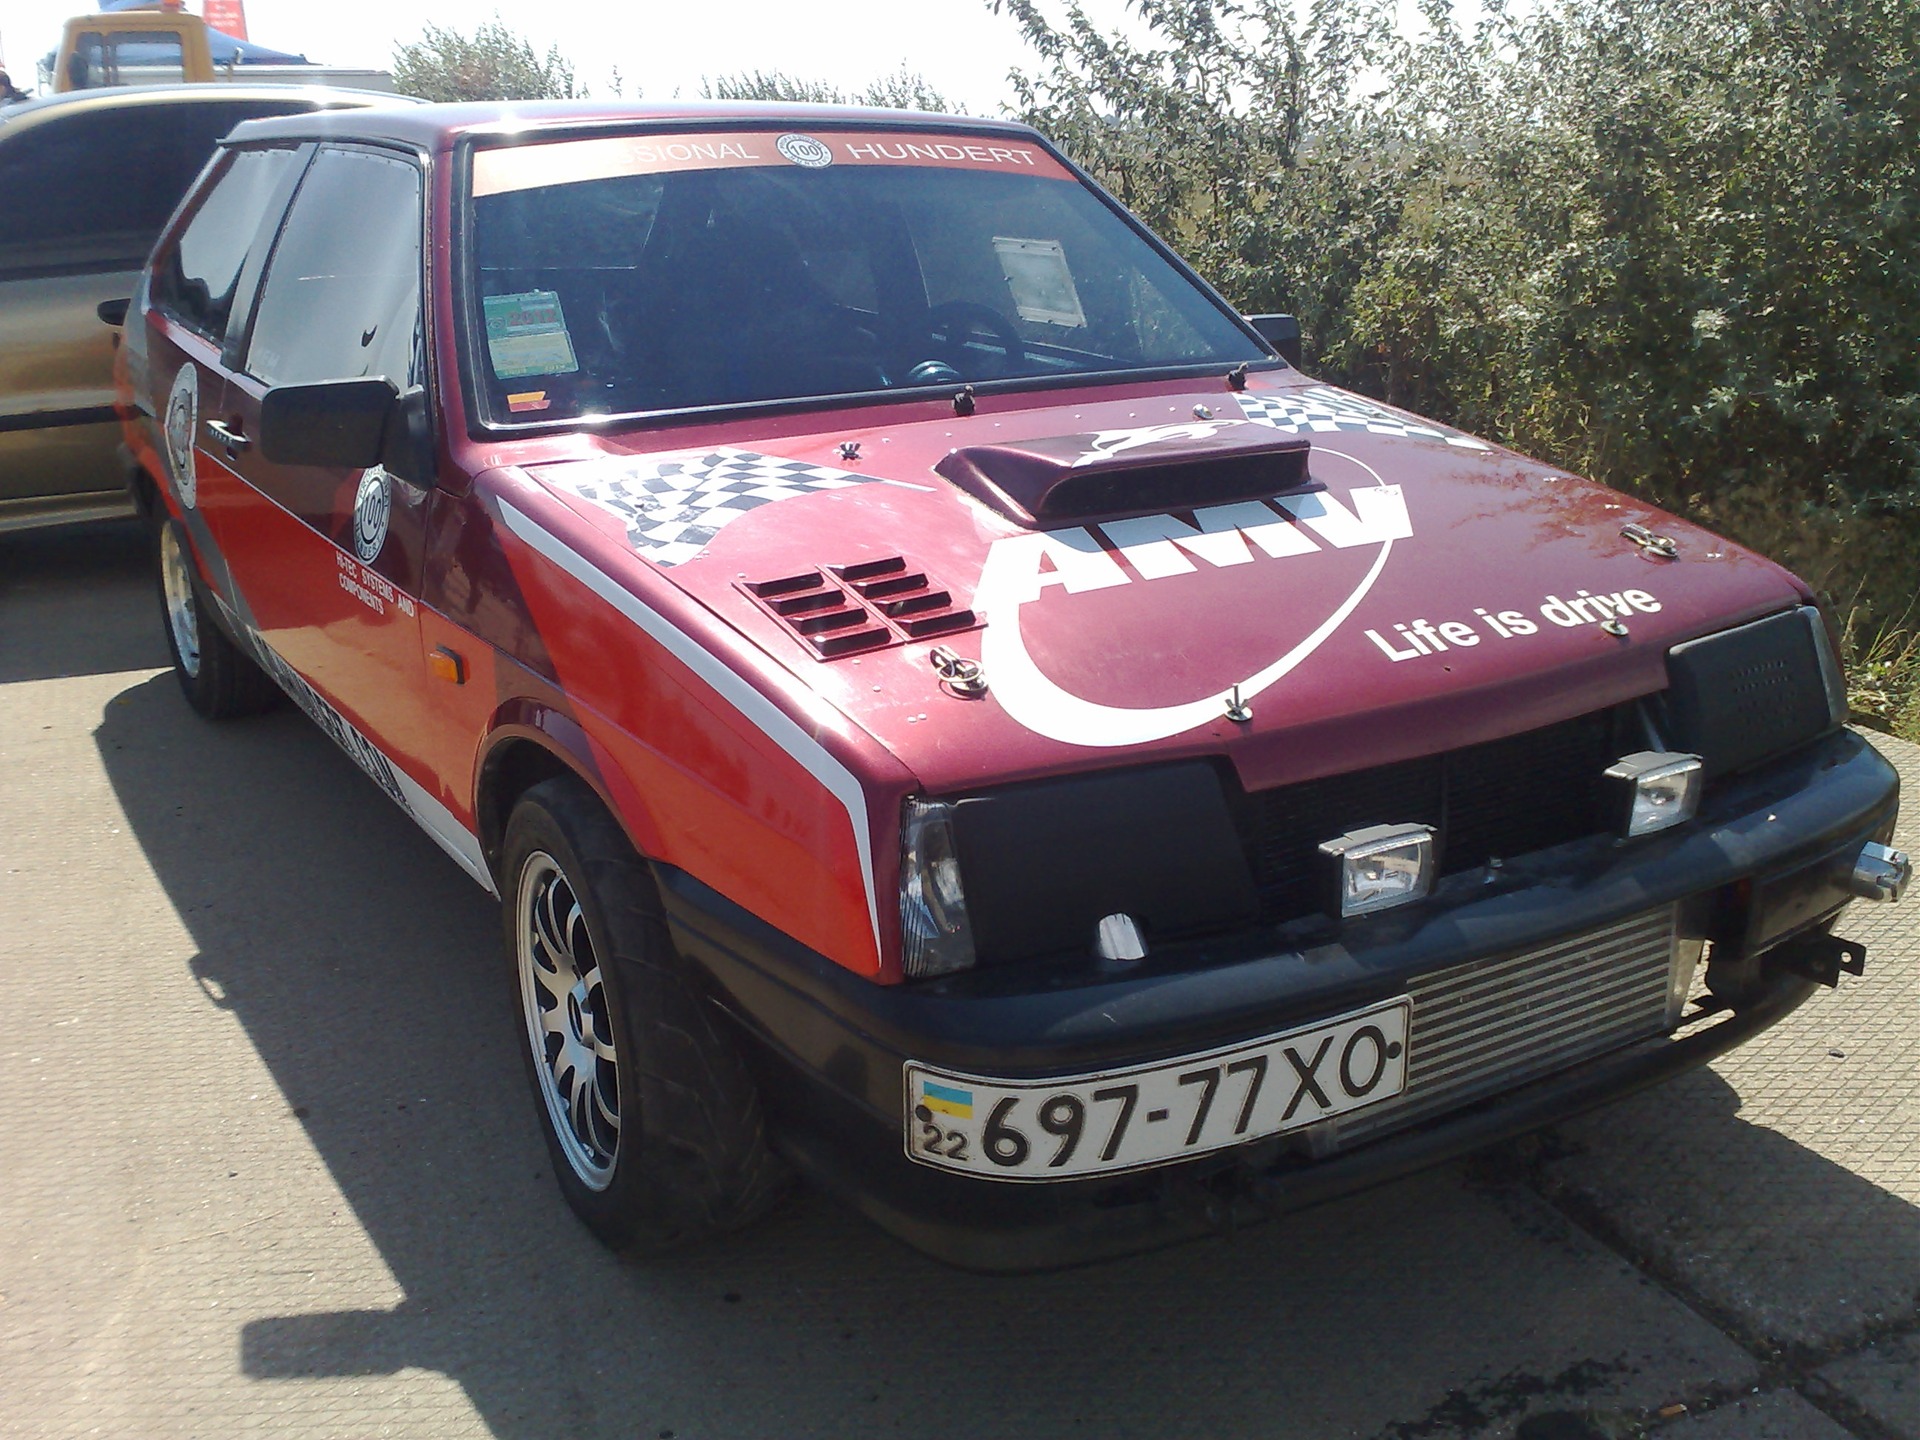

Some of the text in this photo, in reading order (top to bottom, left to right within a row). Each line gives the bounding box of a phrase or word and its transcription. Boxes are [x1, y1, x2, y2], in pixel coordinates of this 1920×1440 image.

[790, 144, 820, 156] 100
[845, 143, 1035, 165] HUNDERT
[362, 490, 381, 529] 100
[336, 550, 415, 618] HI-TEC SYSTEMS AND
[339, 573, 385, 615] COMPONENTS
[1363, 589, 1663, 663] Life is drive
[922, 1123, 970, 1161] 22
